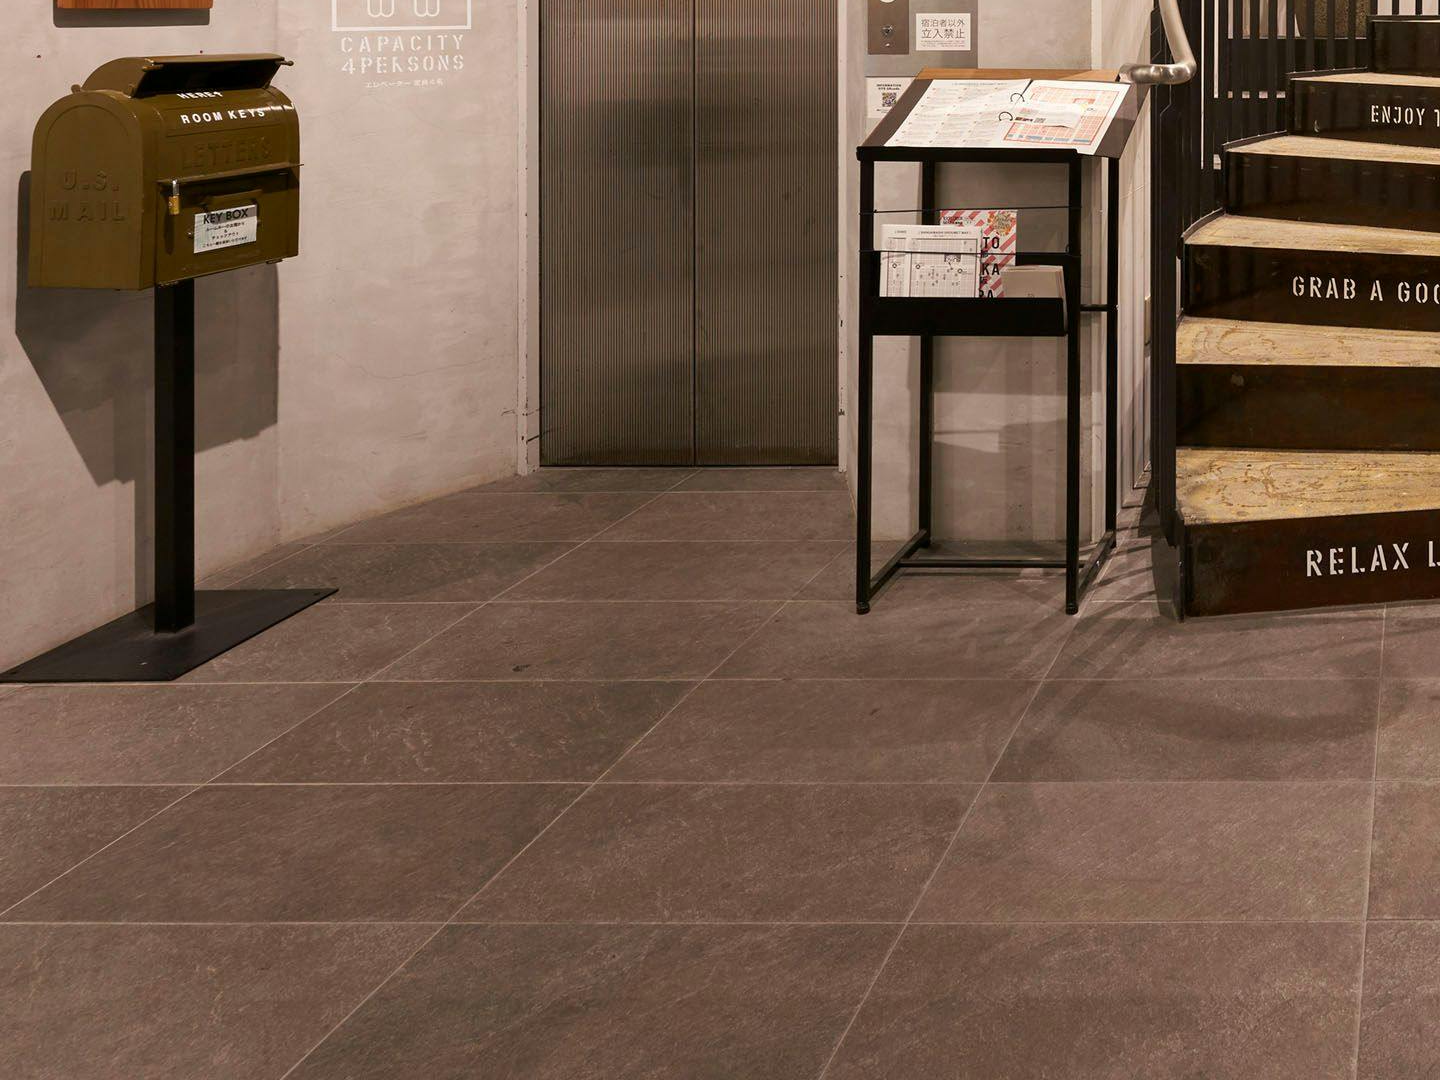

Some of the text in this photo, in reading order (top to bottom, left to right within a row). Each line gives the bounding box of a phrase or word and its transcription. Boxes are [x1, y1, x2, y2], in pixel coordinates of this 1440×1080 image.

[920, 18, 965, 28] 宿泊者以外
[340, 34, 464, 53] CAPACITY
[921, 28, 966, 40] 立入禁止
[180, 106, 266, 124] ROOM KEYS
[1370, 104, 1426, 126] ENJOY
[48, 200, 126, 222] MAIL
[203, 208, 249, 225] KEY BOX
[1292, 275, 1356, 300] GRAB
[1369, 280, 1384, 302] A
[1305, 541, 1410, 577] RELAX
